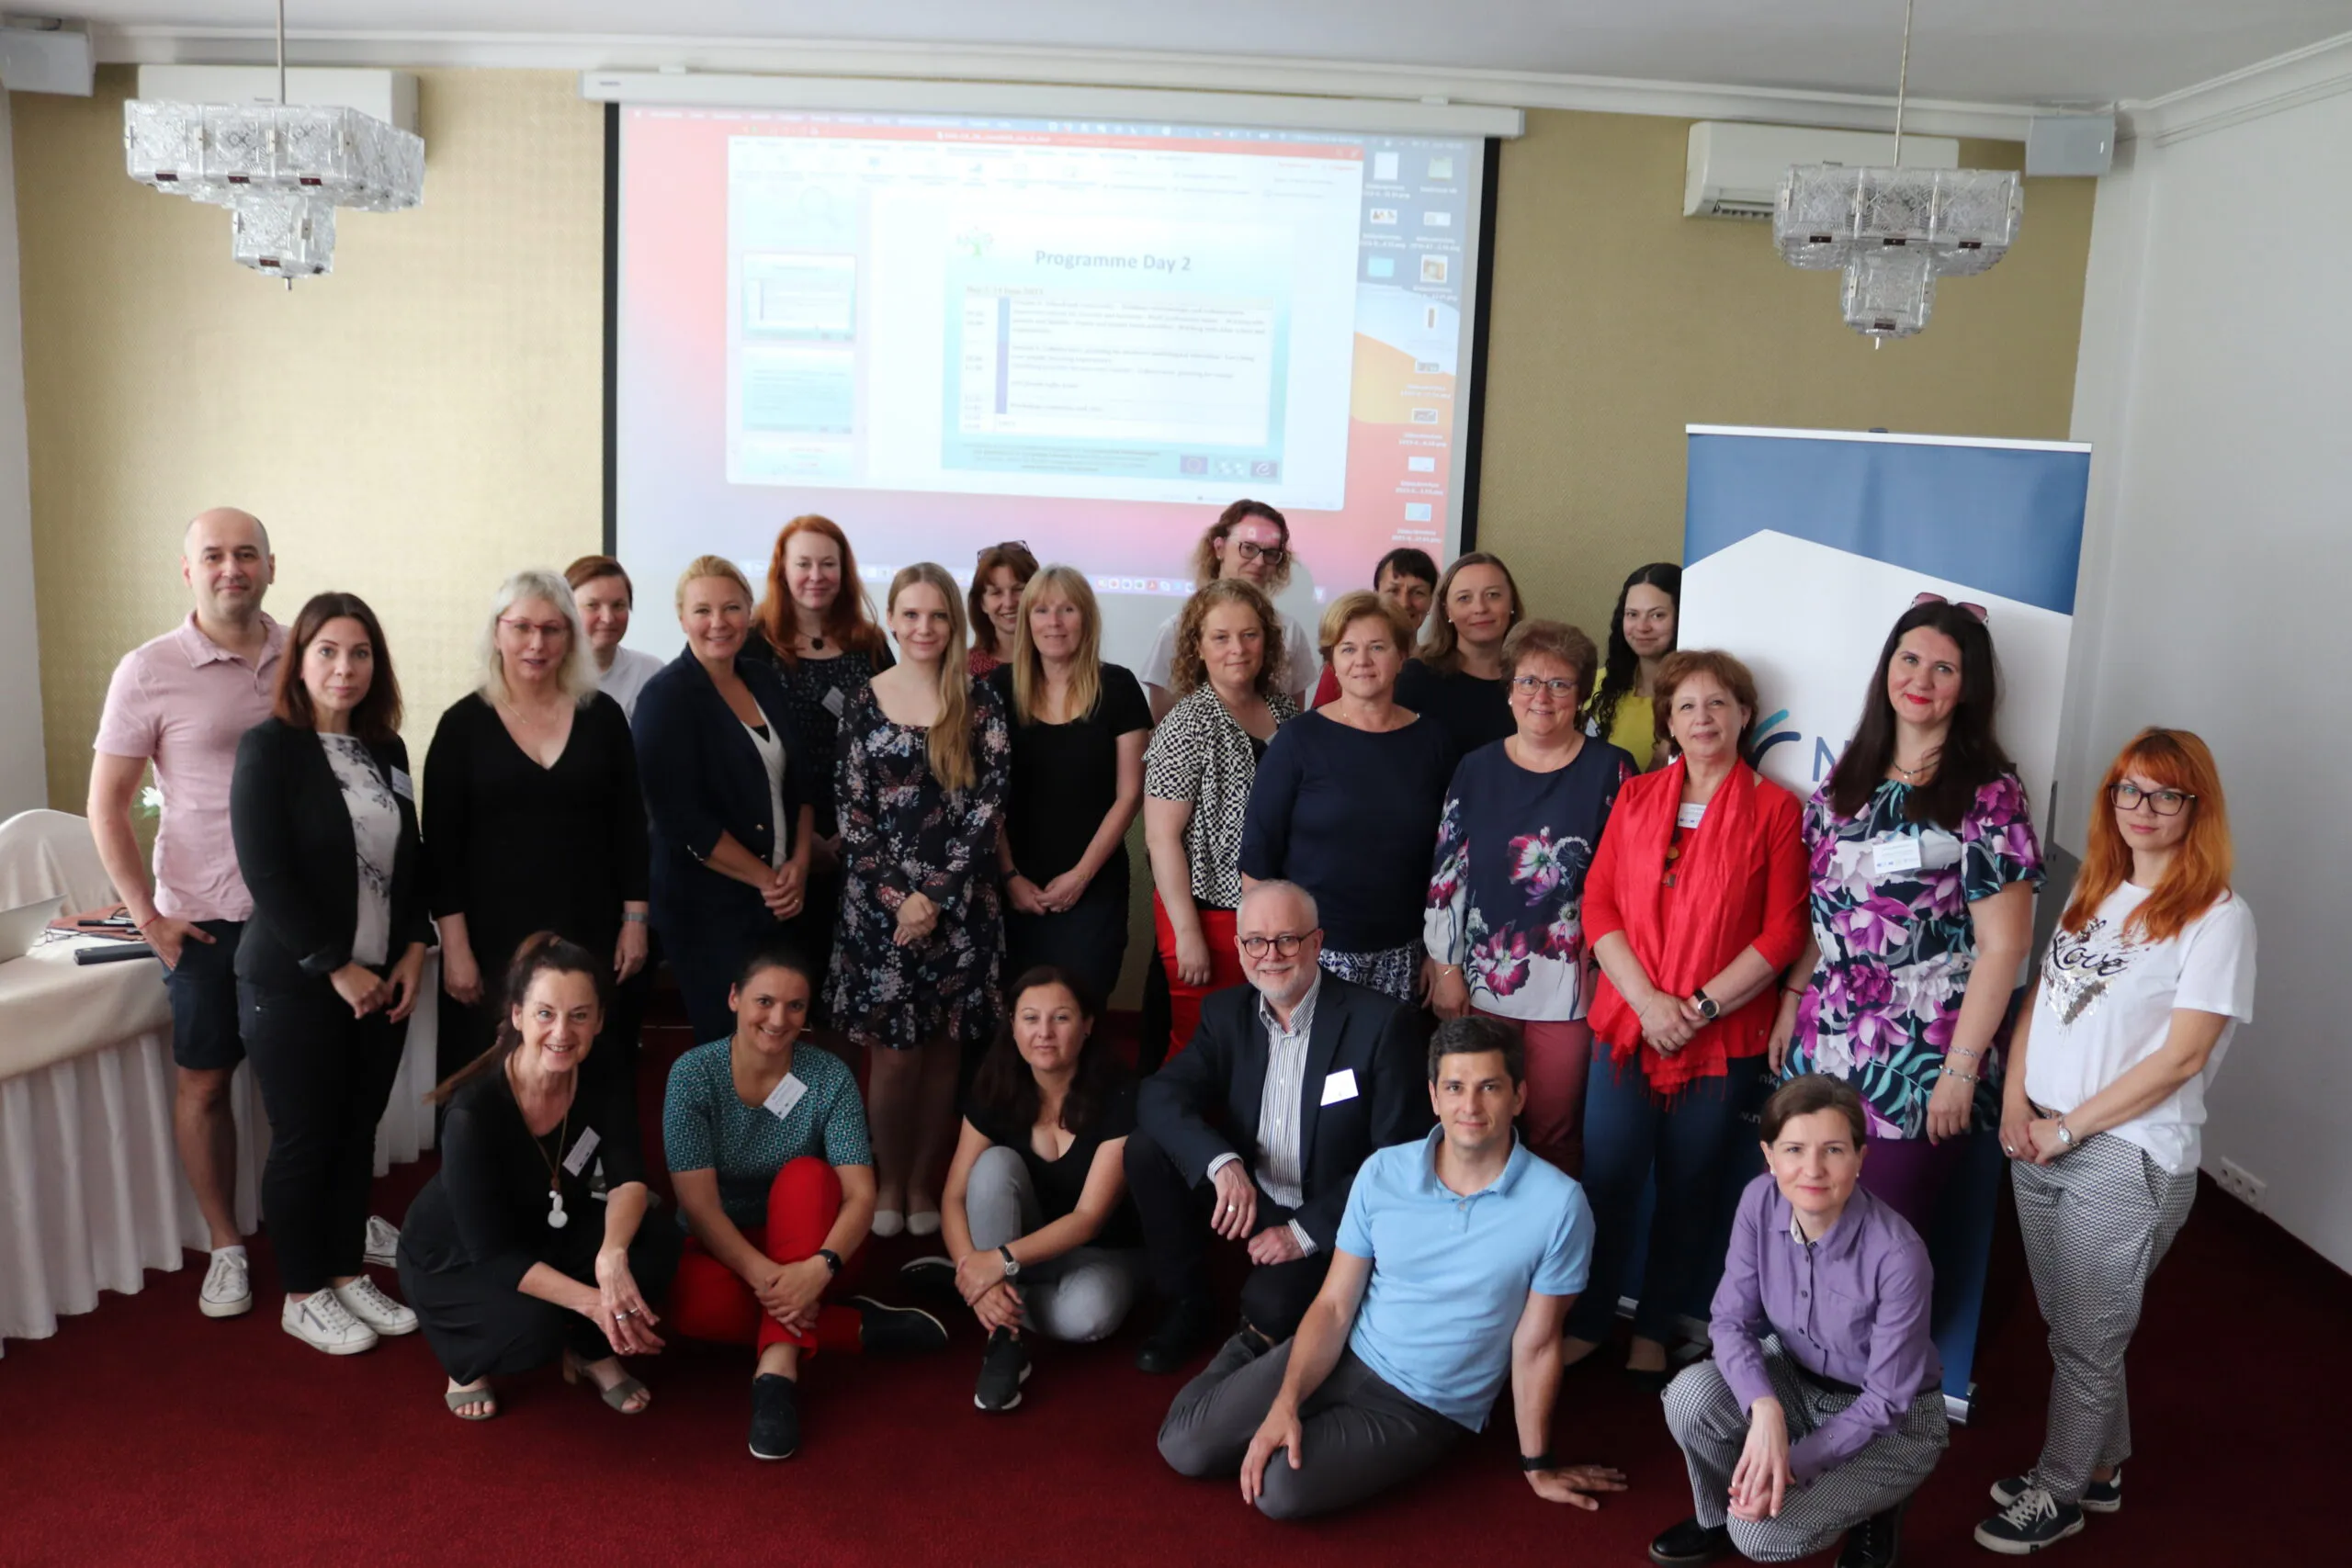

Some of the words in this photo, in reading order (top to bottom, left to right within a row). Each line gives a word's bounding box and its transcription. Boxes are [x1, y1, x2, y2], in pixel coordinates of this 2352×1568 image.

[1035, 250, 1138, 270] Programme
[1143, 254, 1177, 274] Day
[1181, 255, 1192, 271] 2
